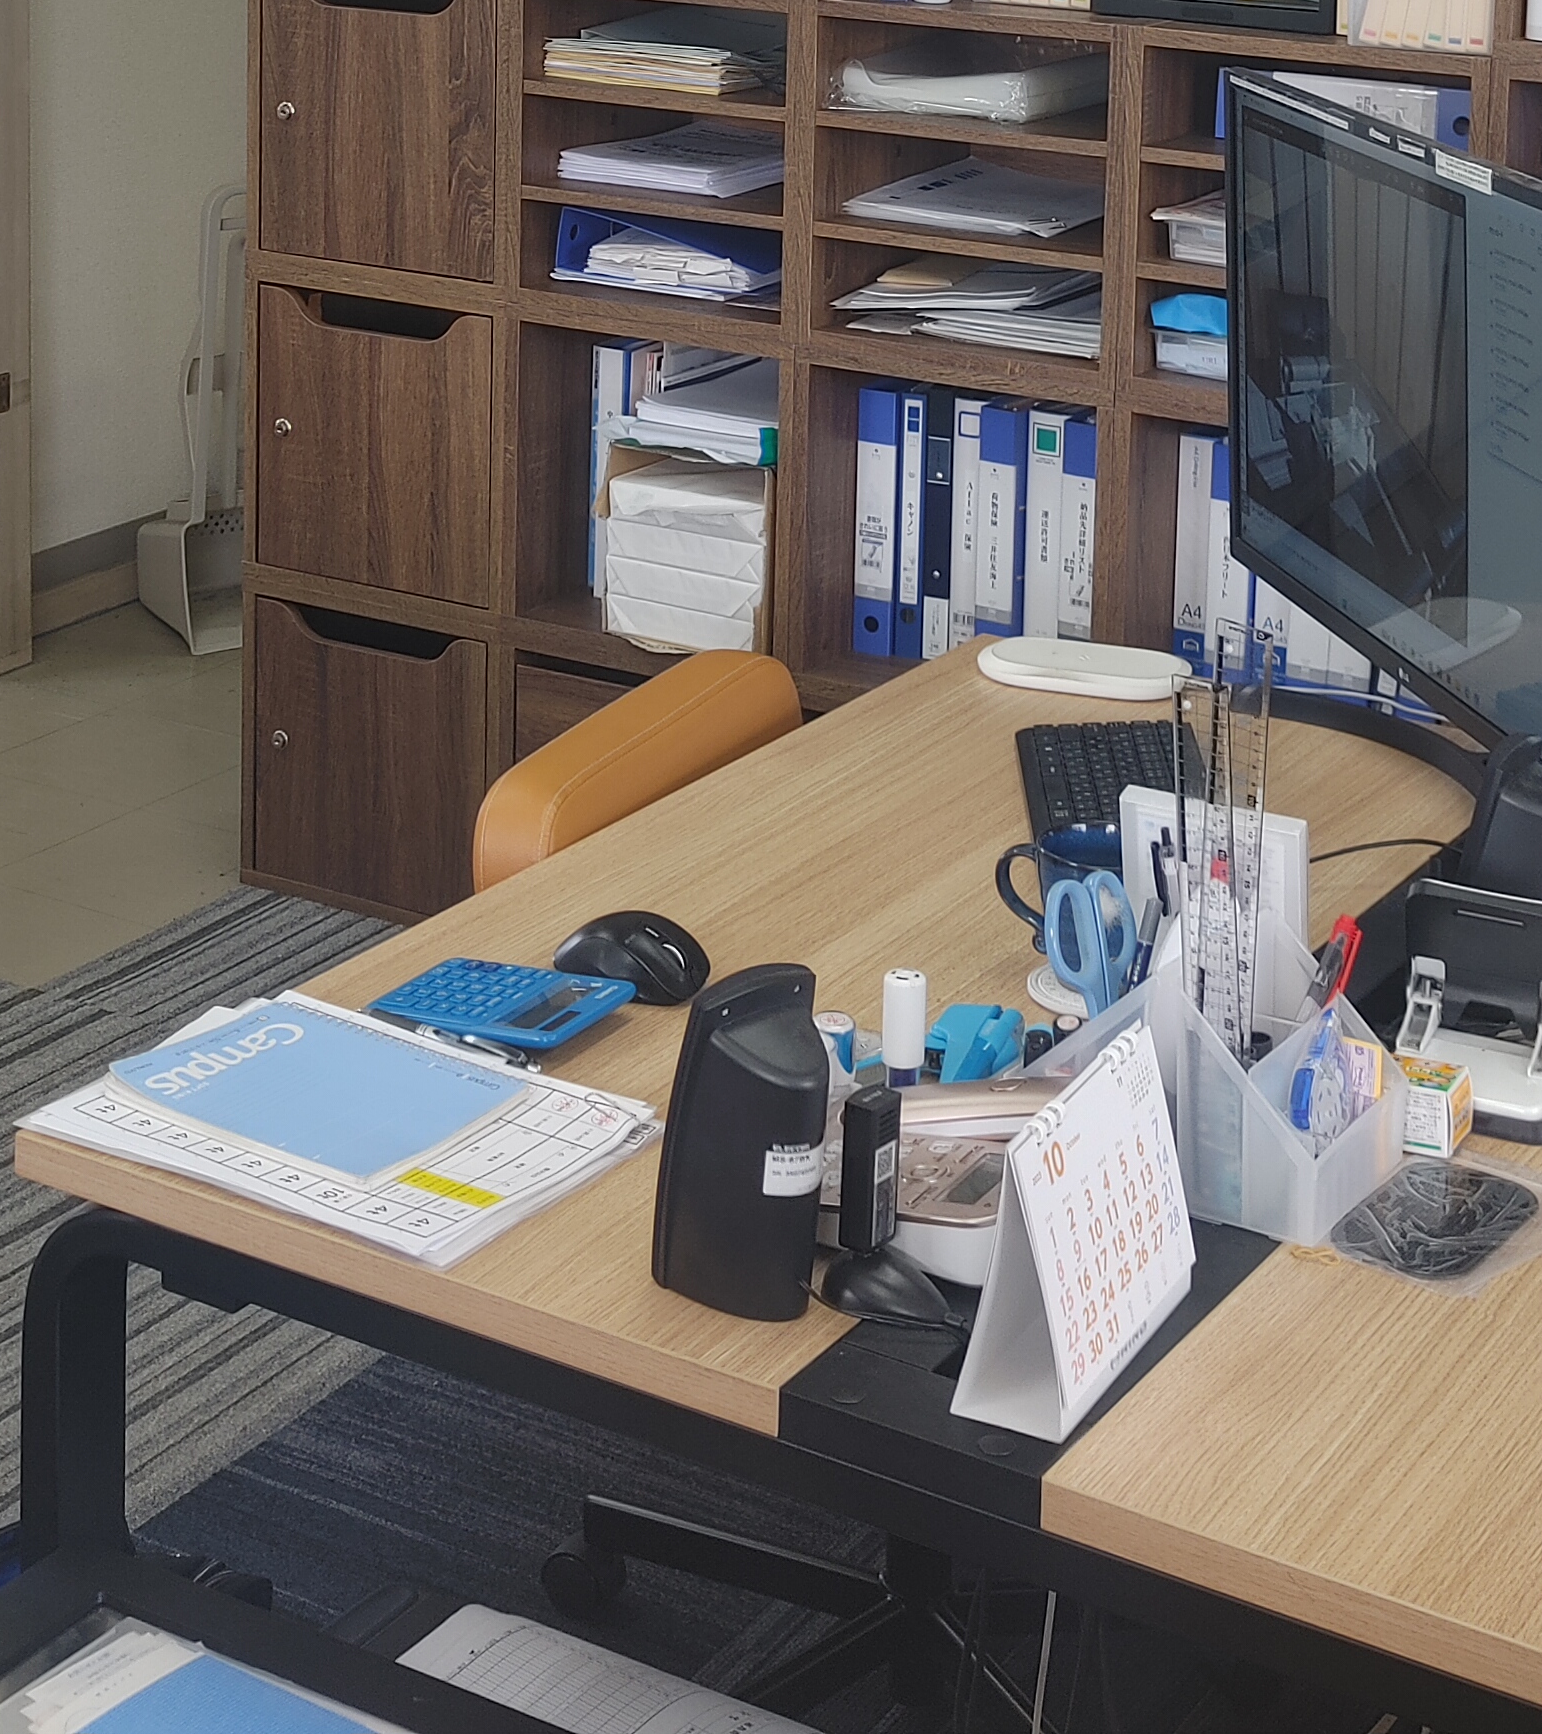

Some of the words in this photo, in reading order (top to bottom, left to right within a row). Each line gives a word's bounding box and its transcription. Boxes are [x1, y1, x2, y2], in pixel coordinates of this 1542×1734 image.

[1181, 603, 1203, 620] A4
[143, 1022, 305, 1098] Campus
[1042, 1141, 1066, 1185] 10
[1049, 1226, 1058, 1249] 1
[1066, 1206, 1077, 1232] 2
[1084, 1188, 1094, 1212] 3
[1102, 1169, 1111, 1191] 4
[1118, 1151, 1128, 1175] 5
[1135, 1134, 1145, 1157] 6
[1151, 1116, 1159, 1142] 7
[1055, 1259, 1065, 1282] 8
[1073, 1239, 1082, 1263] 9
[1088, 1216, 1103, 1246] 10
[1106, 1198, 1120, 1227] 11
[1122, 1180, 1138, 1208] 12
[1139, 1162, 1154, 1190] 13
[1155, 1144, 1170, 1173] 14
[1059, 1286, 1075, 1318] 15
[1076, 1266, 1092, 1298] 16
[1094, 1247, 1108, 1277] 17
[1112, 1229, 1127, 1259] 18
[1129, 1211, 1143, 1240] 19
[1145, 1193, 1160, 1223] 20
[1161, 1175, 1175, 1206] 21
[1065, 1319, 1081, 1353] 22
[1082, 1299, 1098, 1332] 23
[1100, 1279, 1116, 1312] 24
[1117, 1260, 1133, 1292] 25
[1134, 1241, 1149, 1273] 26
[1150, 1222, 1164, 1254] 27
[1167, 1205, 1181, 1236] 28
[1070, 1352, 1086, 1386] 29
[1088, 1332, 1104, 1364] 30
[1105, 1312, 1121, 1344] 31
